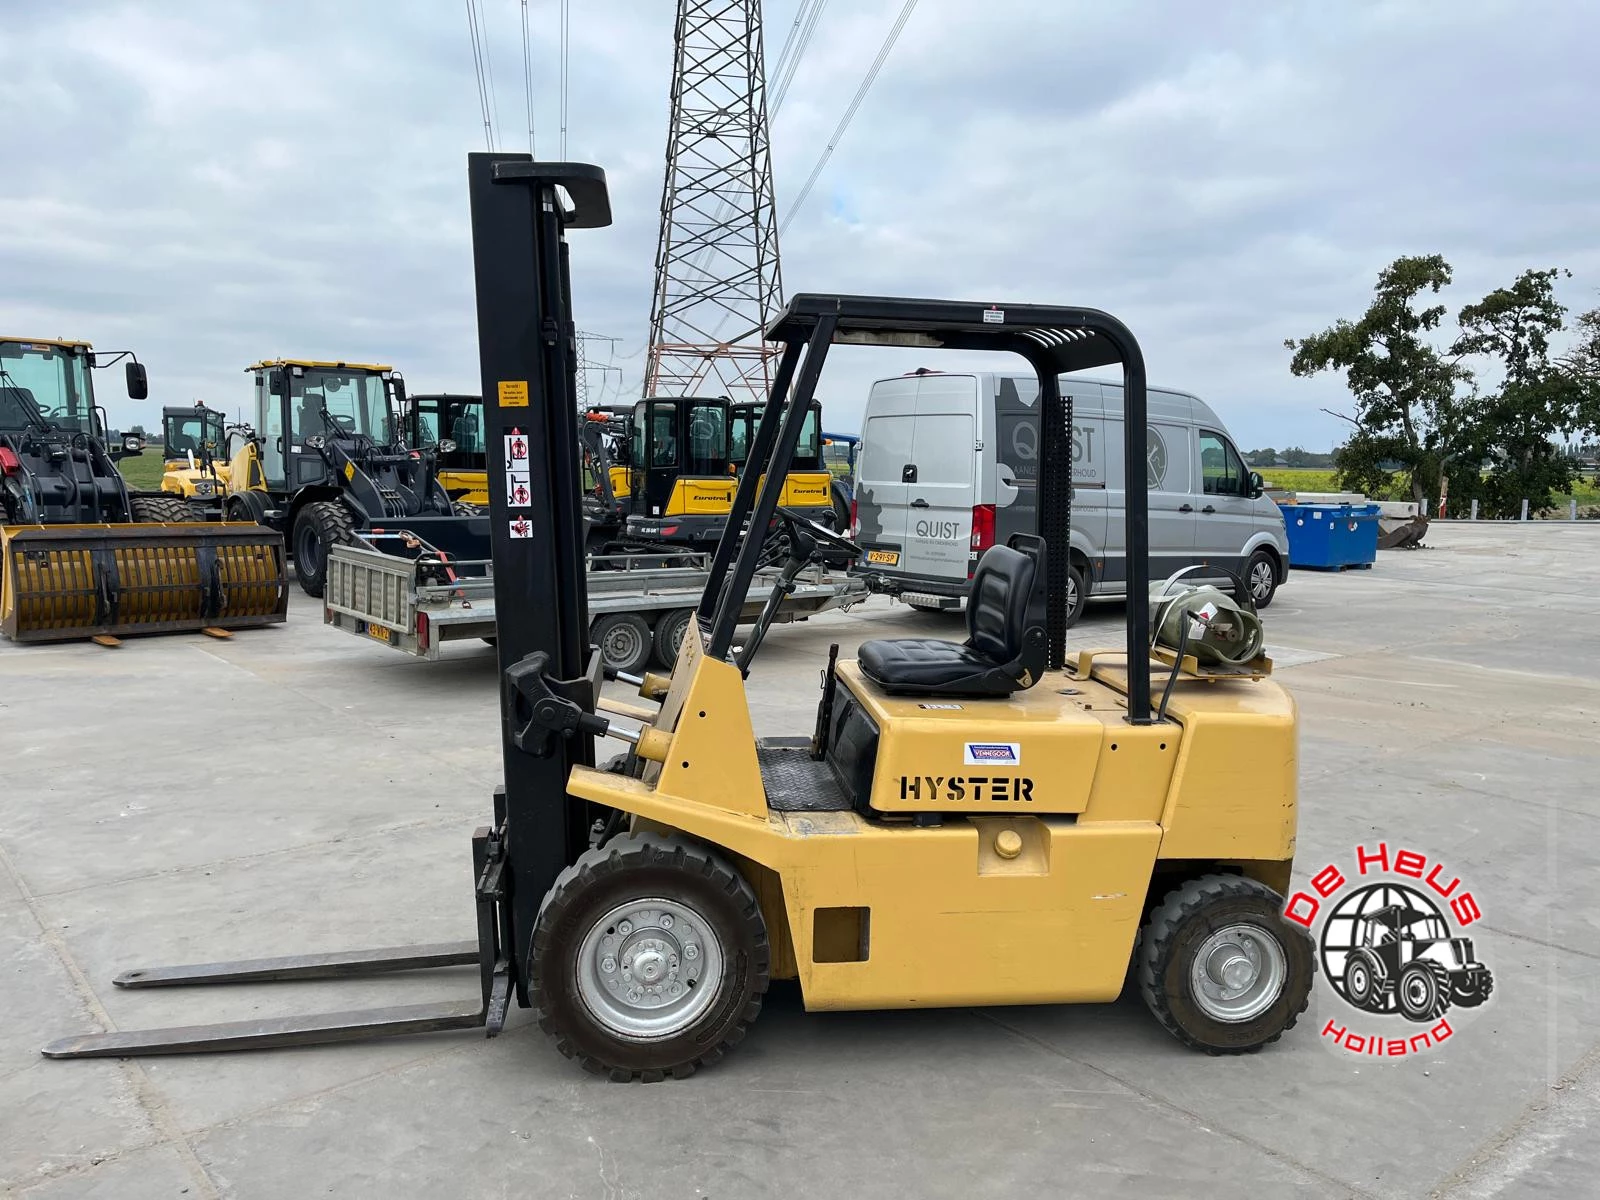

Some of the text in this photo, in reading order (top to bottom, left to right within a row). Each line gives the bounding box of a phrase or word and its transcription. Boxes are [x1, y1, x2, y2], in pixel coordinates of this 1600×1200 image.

[1012, 421, 1095, 463] QST
[1013, 465, 1037, 475] AANLE
[916, 519, 960, 539] QUIST
[900, 776, 1034, 801] HYSTER
